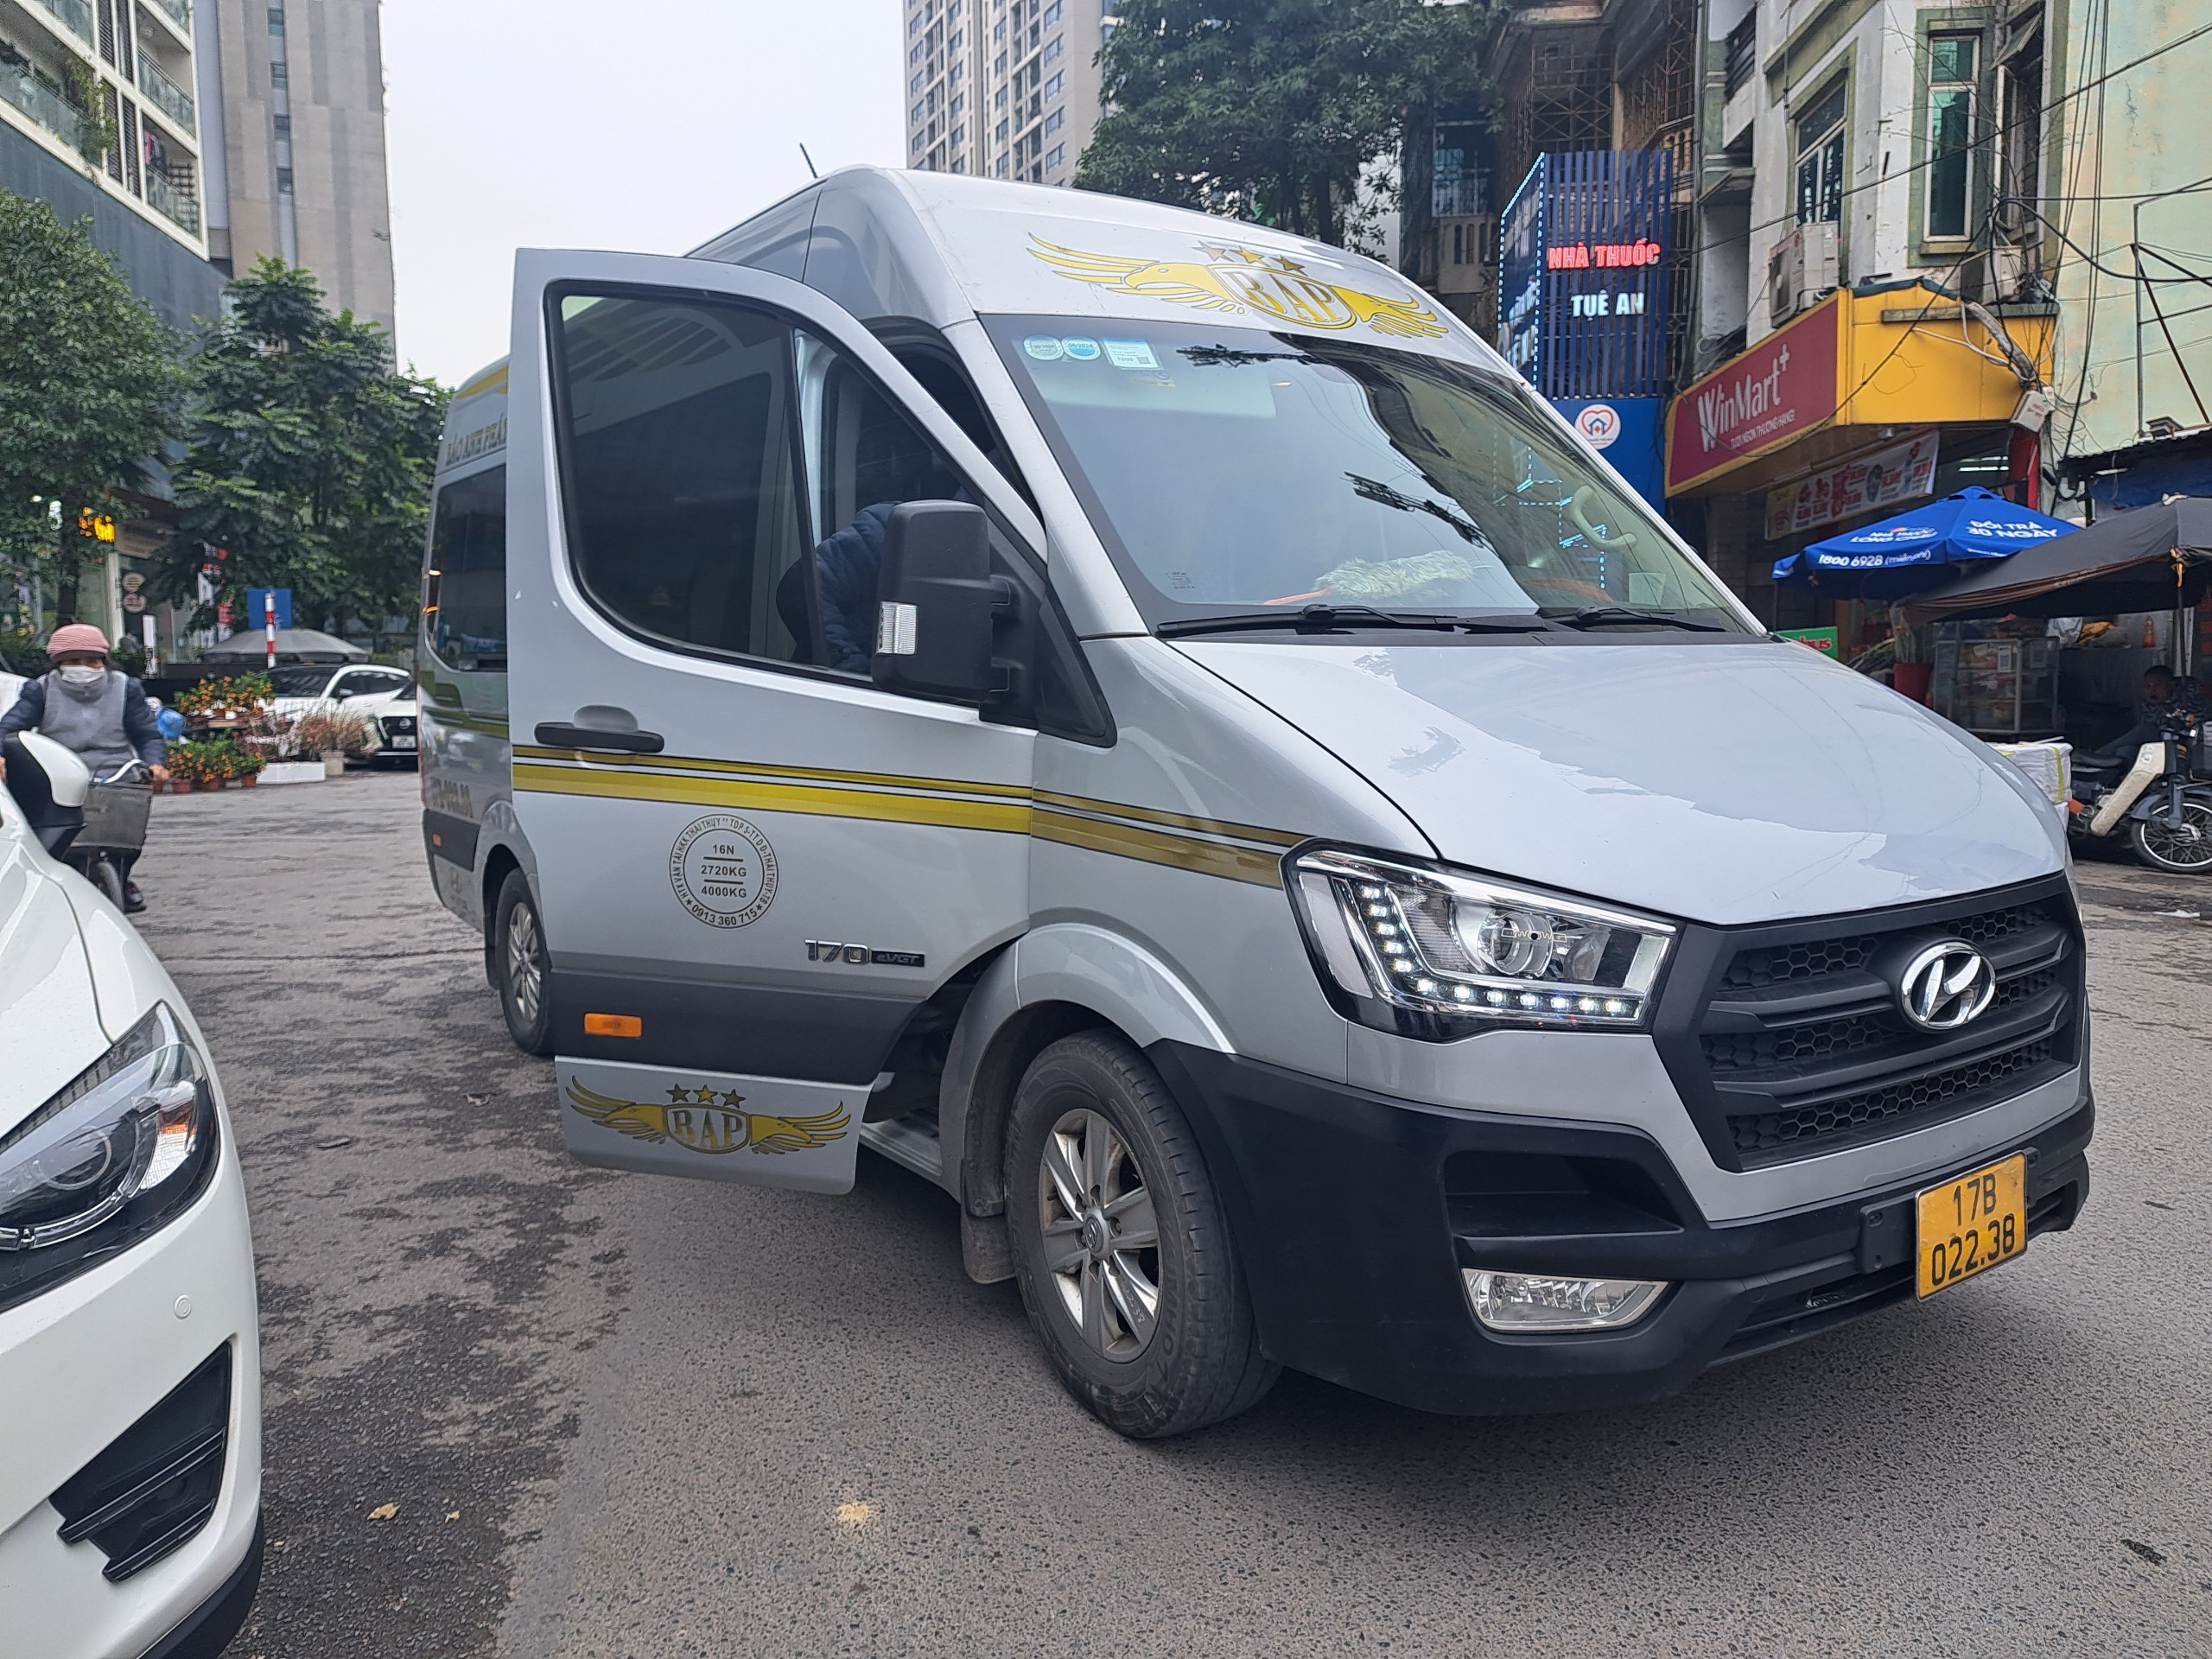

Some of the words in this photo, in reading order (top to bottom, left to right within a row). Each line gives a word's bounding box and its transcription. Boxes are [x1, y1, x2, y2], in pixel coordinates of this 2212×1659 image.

[1548, 241, 1590, 270] NHÀ
[1594, 238, 1661, 268] THUỐC
[1570, 289, 1610, 321] TUỆ
[1615, 292, 1645, 316] AN
[1818, 554, 1850, 566] 1800
[1850, 555, 1884, 567] 6928
[677, 883, 689, 899] HTX
[729, 818, 745, 830] TDP
[712, 844, 734, 855] 16N
[701, 864, 747, 877] 2720KG
[701, 886, 747, 899] 4000KG
[691, 904, 715, 924] 0913
[718, 916, 737, 926] 360
[738, 907, 758, 924] 715
[804, 939, 869, 965] 170
[876, 952, 919, 964] eVGT
[1953, 1173, 1996, 1227] 17B
[1931, 1212, 2015, 1287] 022.38
